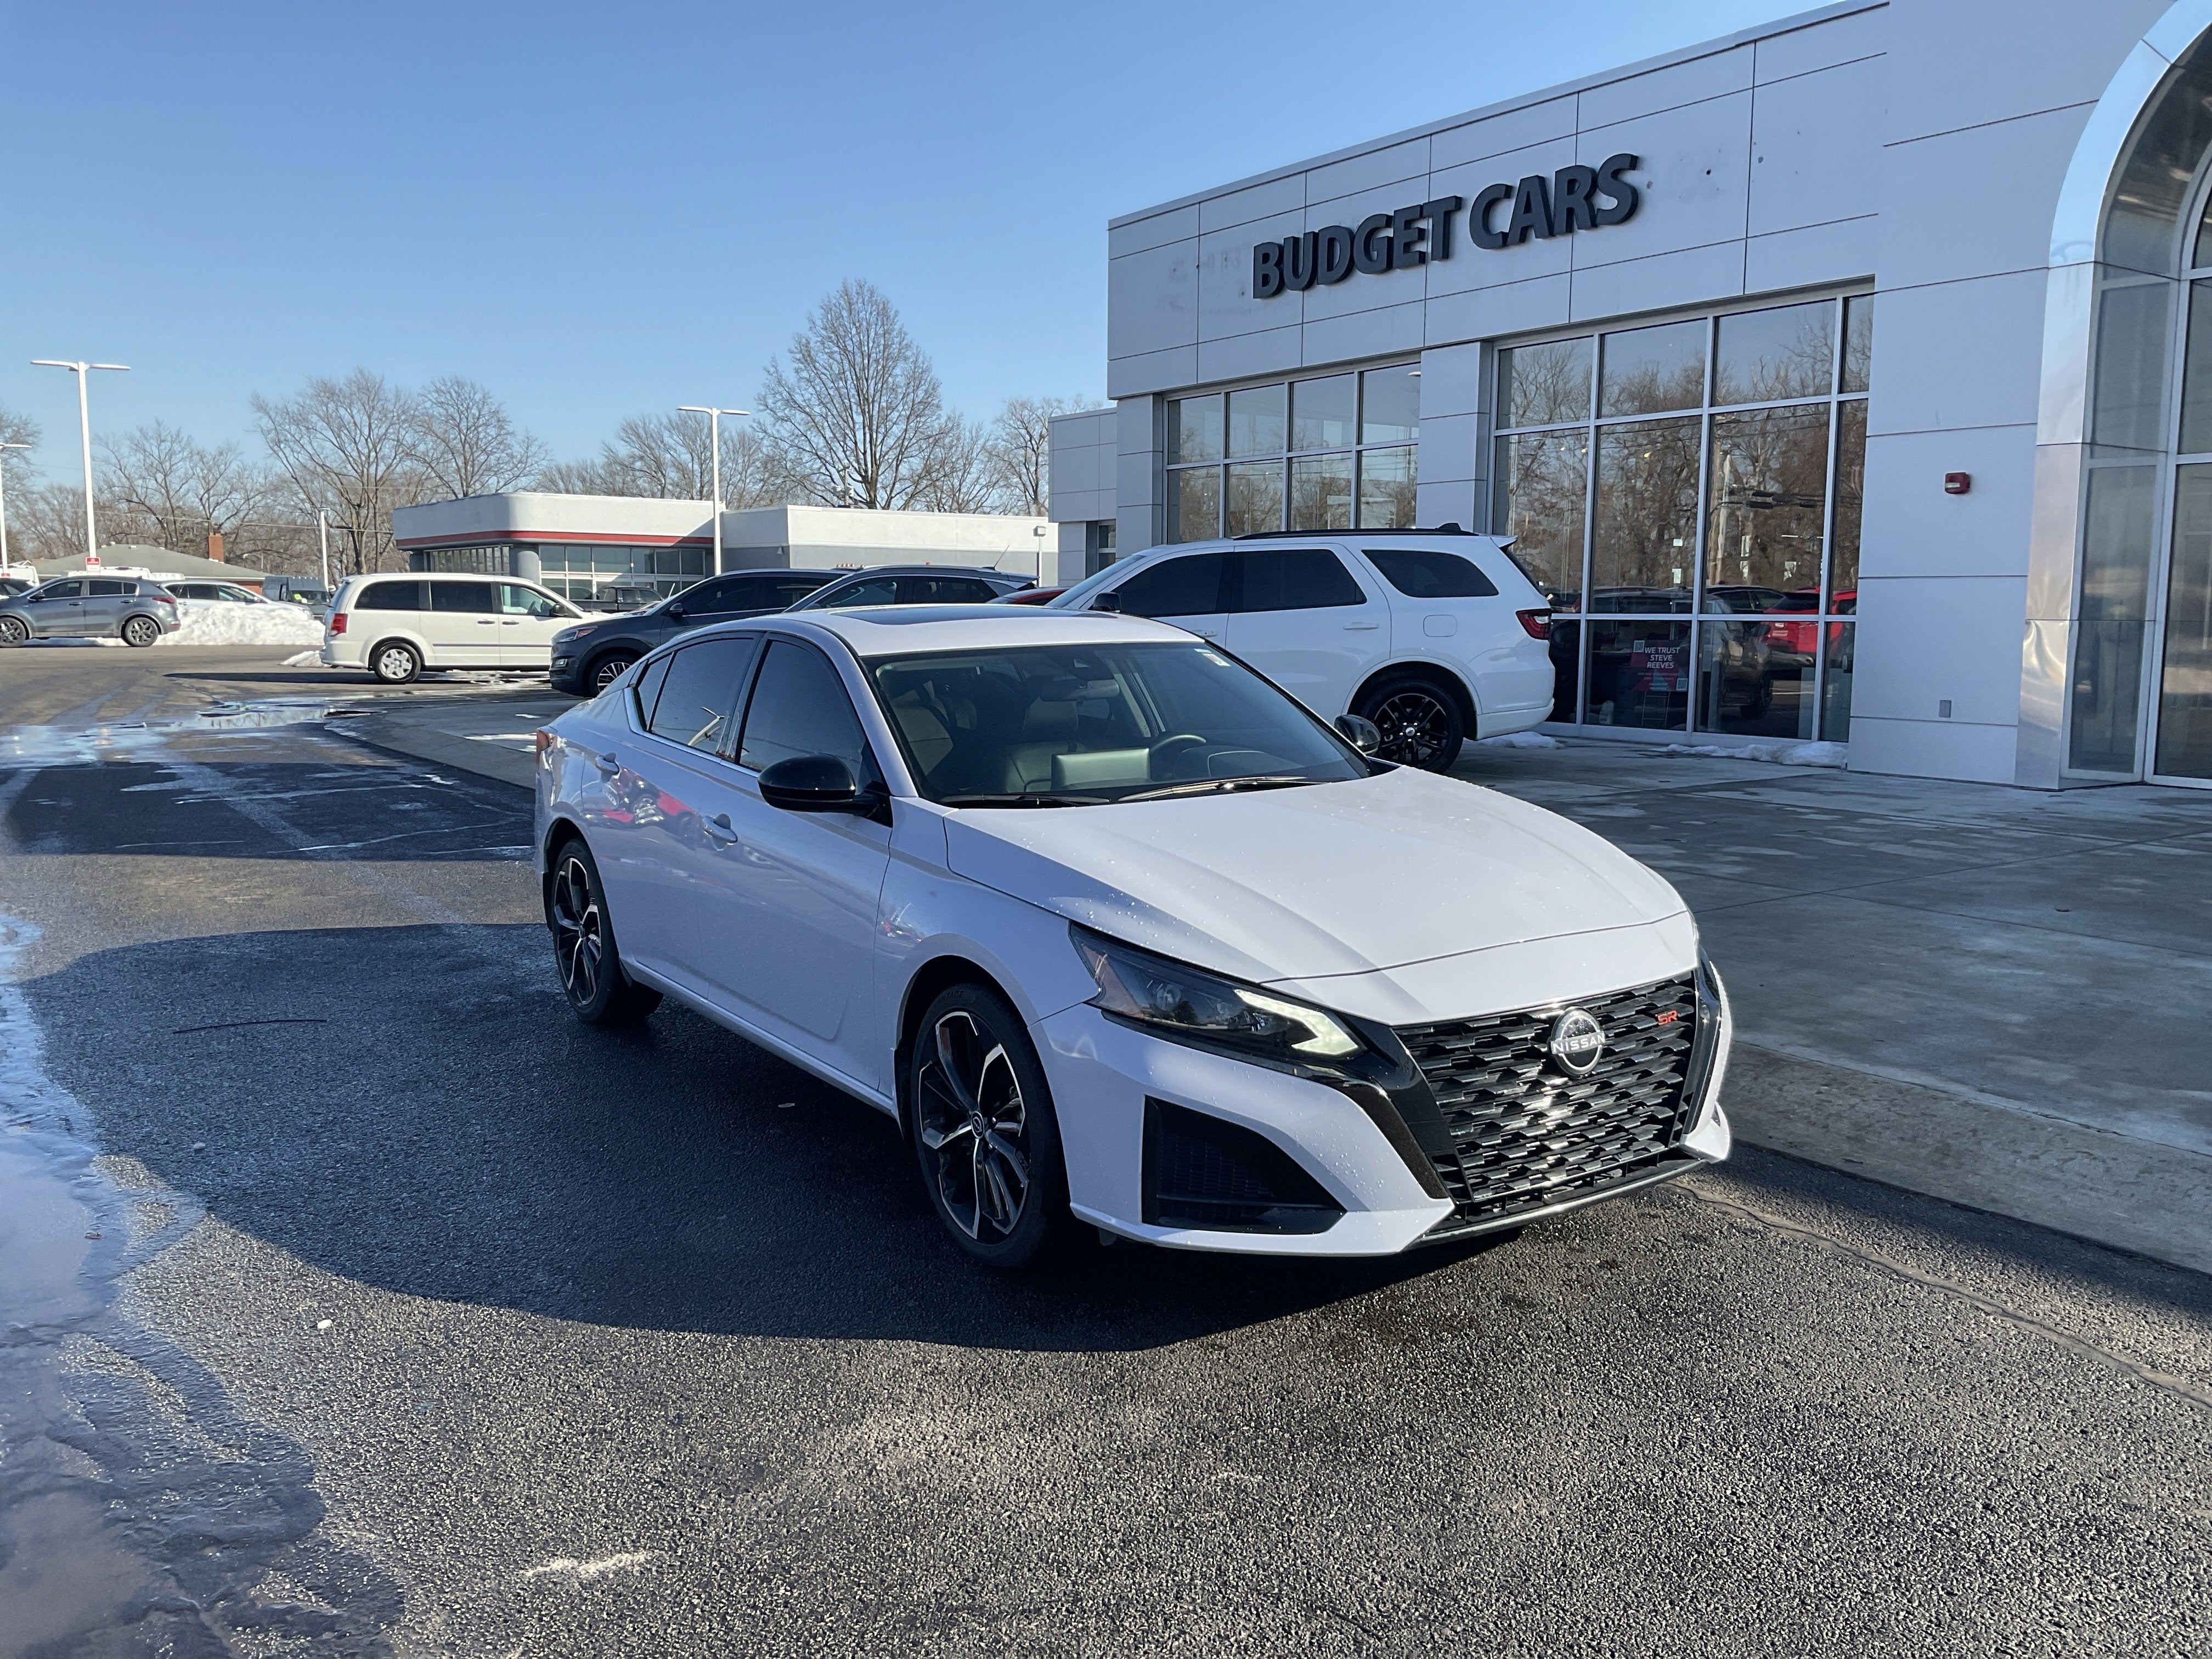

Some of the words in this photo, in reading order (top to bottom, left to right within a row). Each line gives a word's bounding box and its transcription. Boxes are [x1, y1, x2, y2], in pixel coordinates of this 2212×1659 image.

[1253, 195, 1463, 299] BUDGET
[1469, 153, 1639, 250] CARS
[1657, 1009, 1678, 1025] SR
[1552, 1031, 1605, 1054] NISSAN
